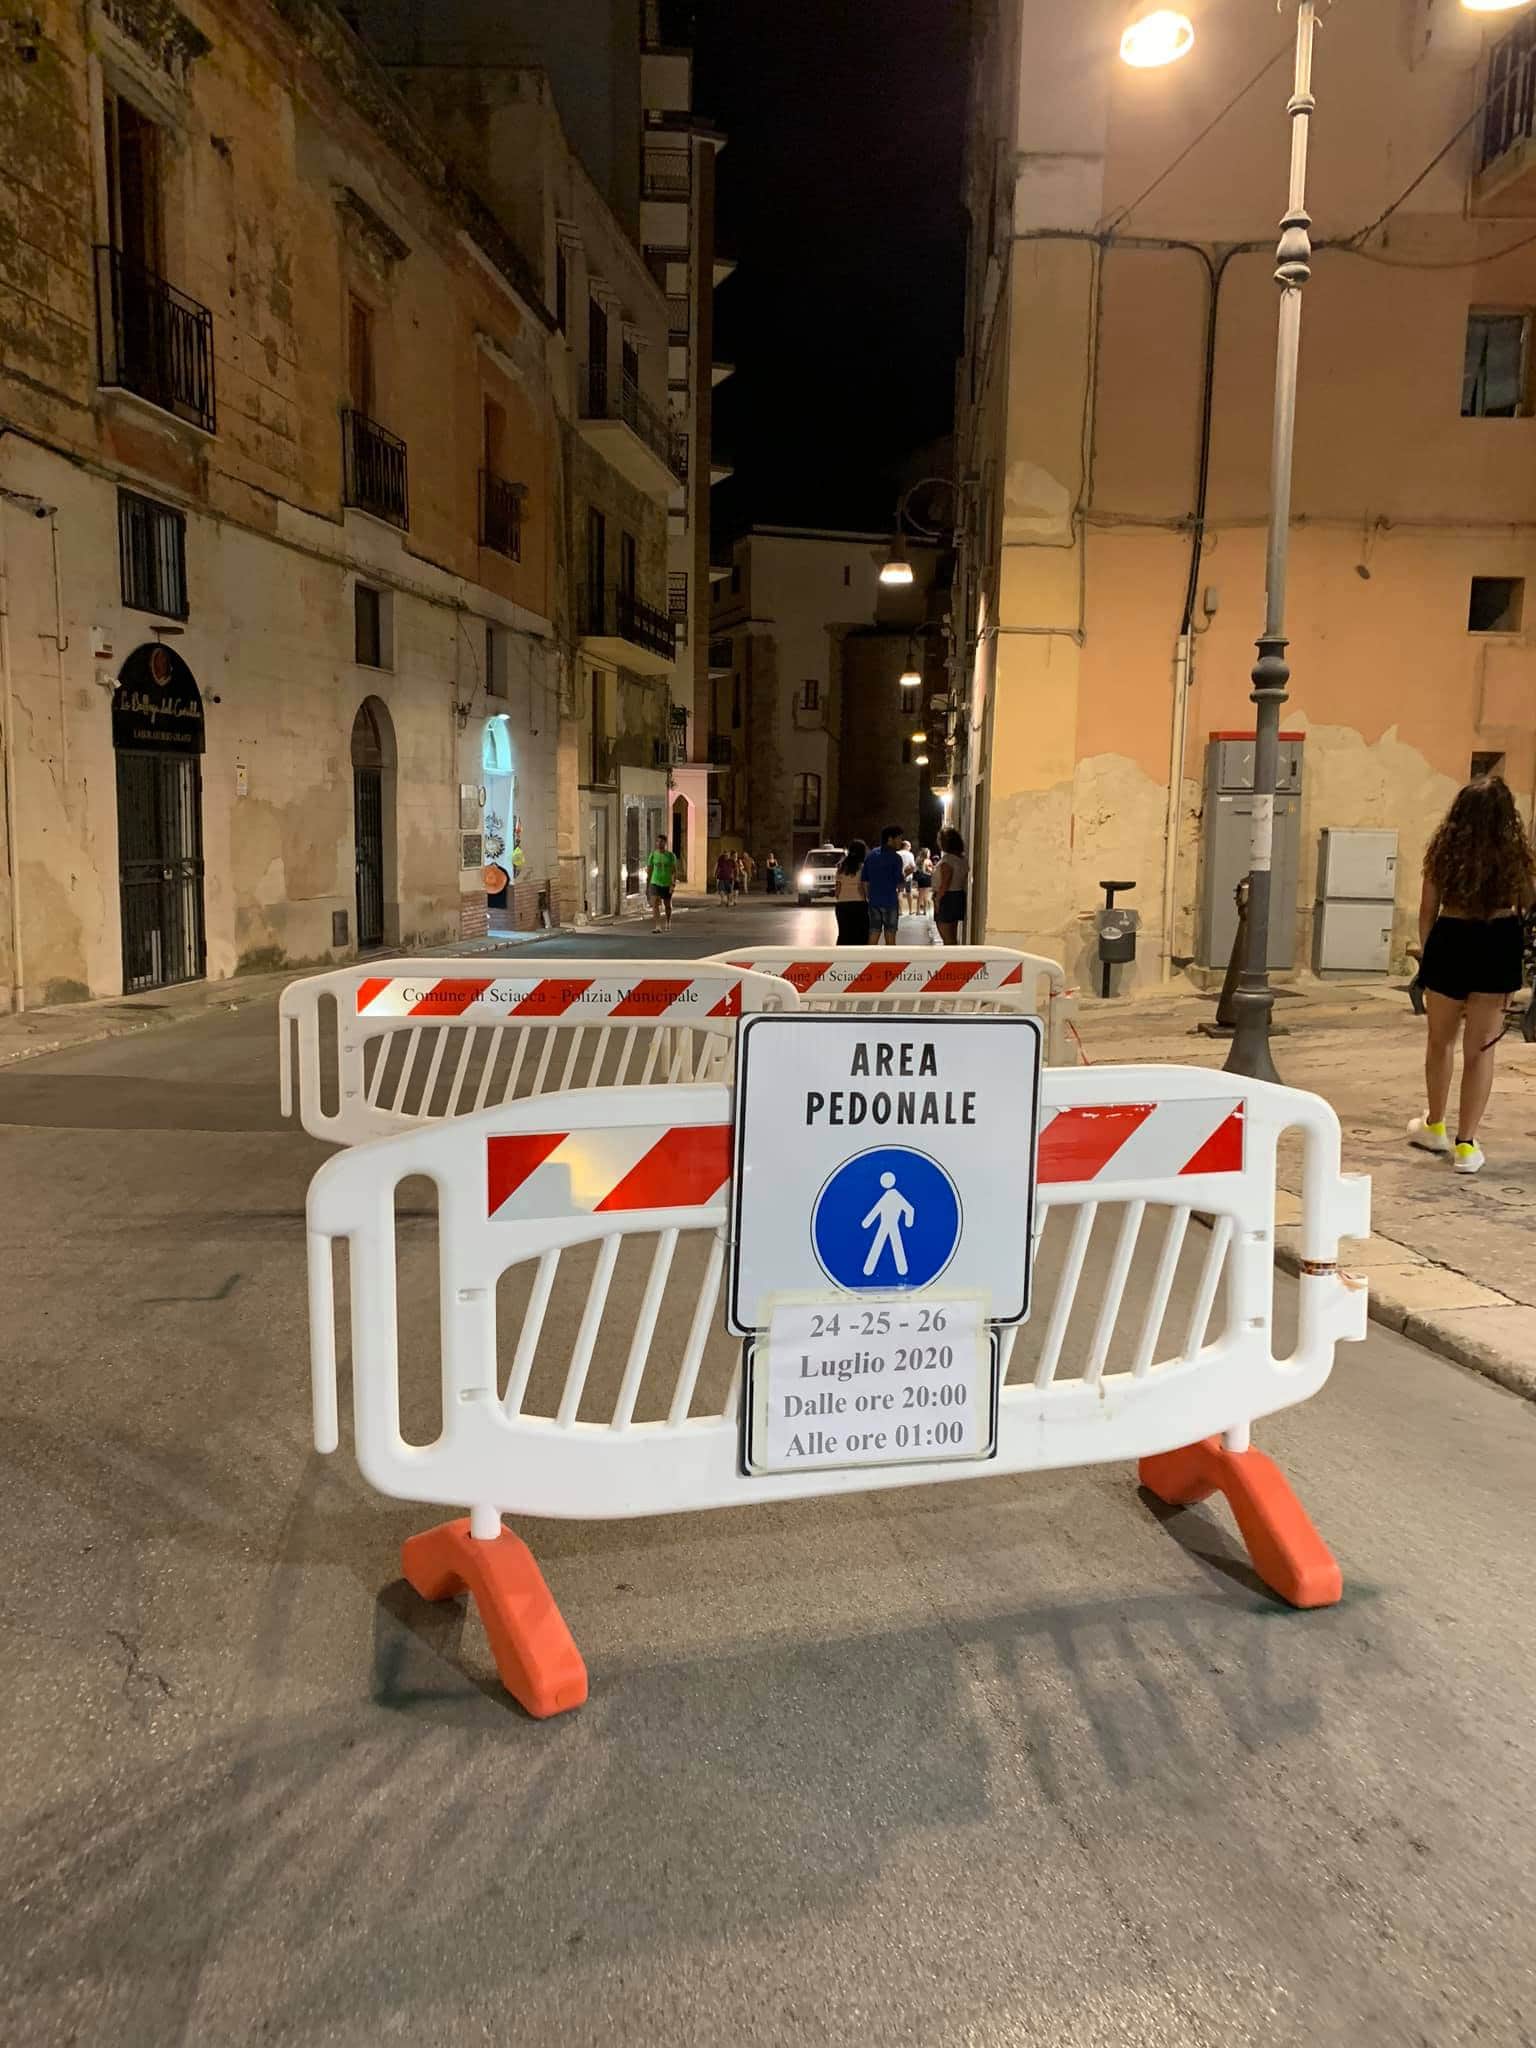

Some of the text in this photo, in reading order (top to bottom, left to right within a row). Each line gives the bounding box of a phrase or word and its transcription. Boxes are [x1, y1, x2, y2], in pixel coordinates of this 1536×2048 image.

[829, 970, 873, 982] Sciacca
[885, 970, 923, 982] Polizia
[927, 968, 990, 983] Municipale
[402, 987, 466, 1003] Comune
[470, 988, 485, 1003] di
[489, 987, 546, 1003] Sciacca
[561, 988, 612, 1003] Polizia
[616, 988, 699, 1006] Municipale
[850, 1042, 938, 1077] AREA
[806, 1091, 977, 1126] PEDONALE
[810, 1313, 841, 1338] 24
[917, 1308, 947, 1333] 26
[799, 1345, 953, 1382] Luglio 2020
[783, 1383, 967, 1418] Dalle ore 20:00
[785, 1420, 964, 1457] Alle ore 01:00
